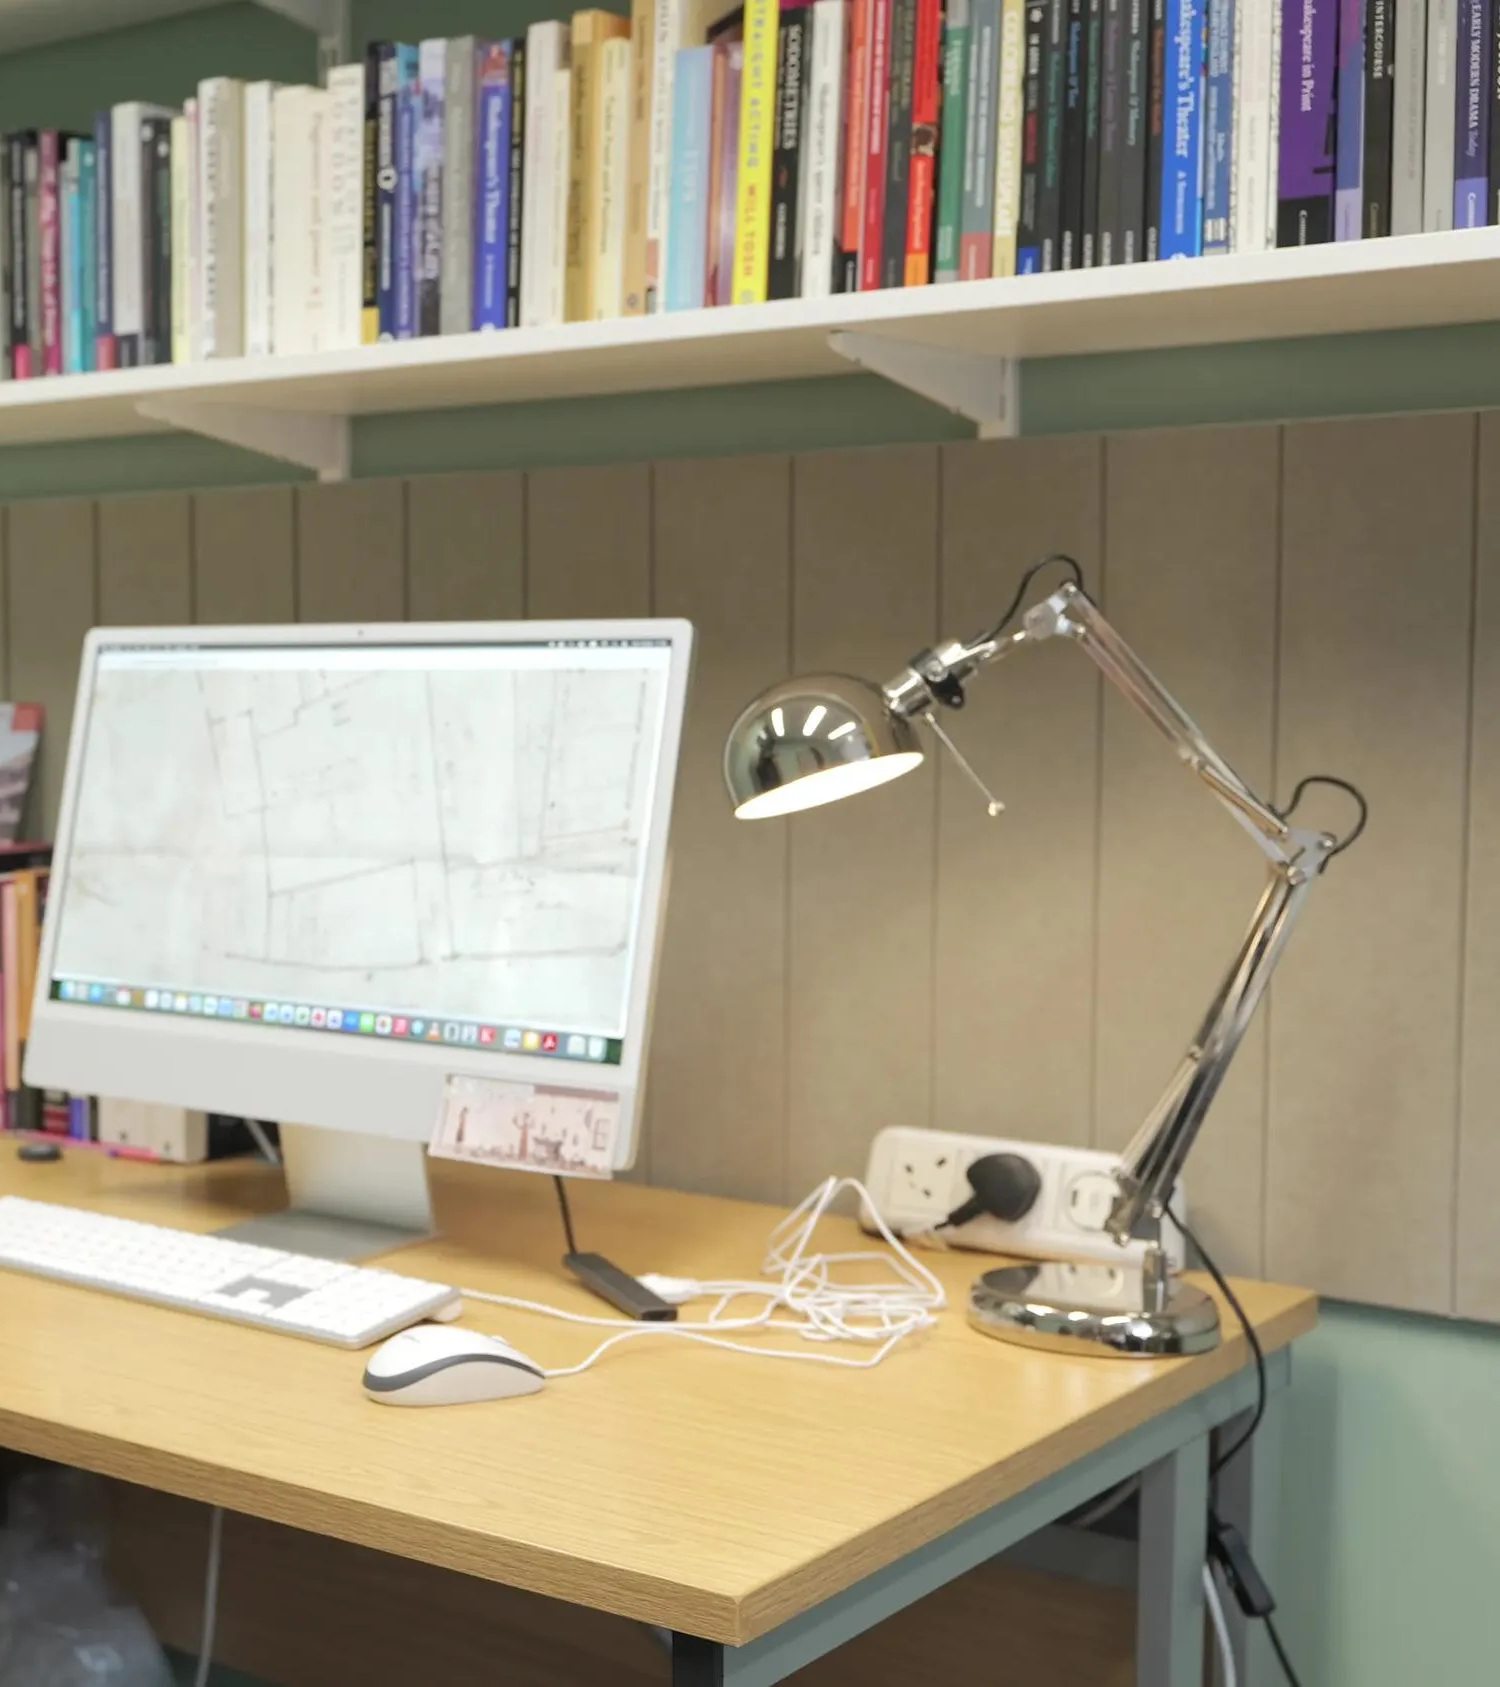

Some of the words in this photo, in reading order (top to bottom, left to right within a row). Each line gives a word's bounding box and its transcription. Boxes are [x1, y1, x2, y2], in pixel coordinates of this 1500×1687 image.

[1372, 0, 1385, 80] INTERCOURSE
[1471, 4, 1482, 38] EARLY
[1301, 64, 1316, 78] in
[1469, 39, 1481, 87] MODERN
[783, 24, 802, 150] SODOMETRIES
[1299, 79, 1315, 113] Print
[1176, 92, 1195, 158] Theater
[1468, 88, 1480, 129] DRAMA
[1465, 130, 1479, 158] Today
